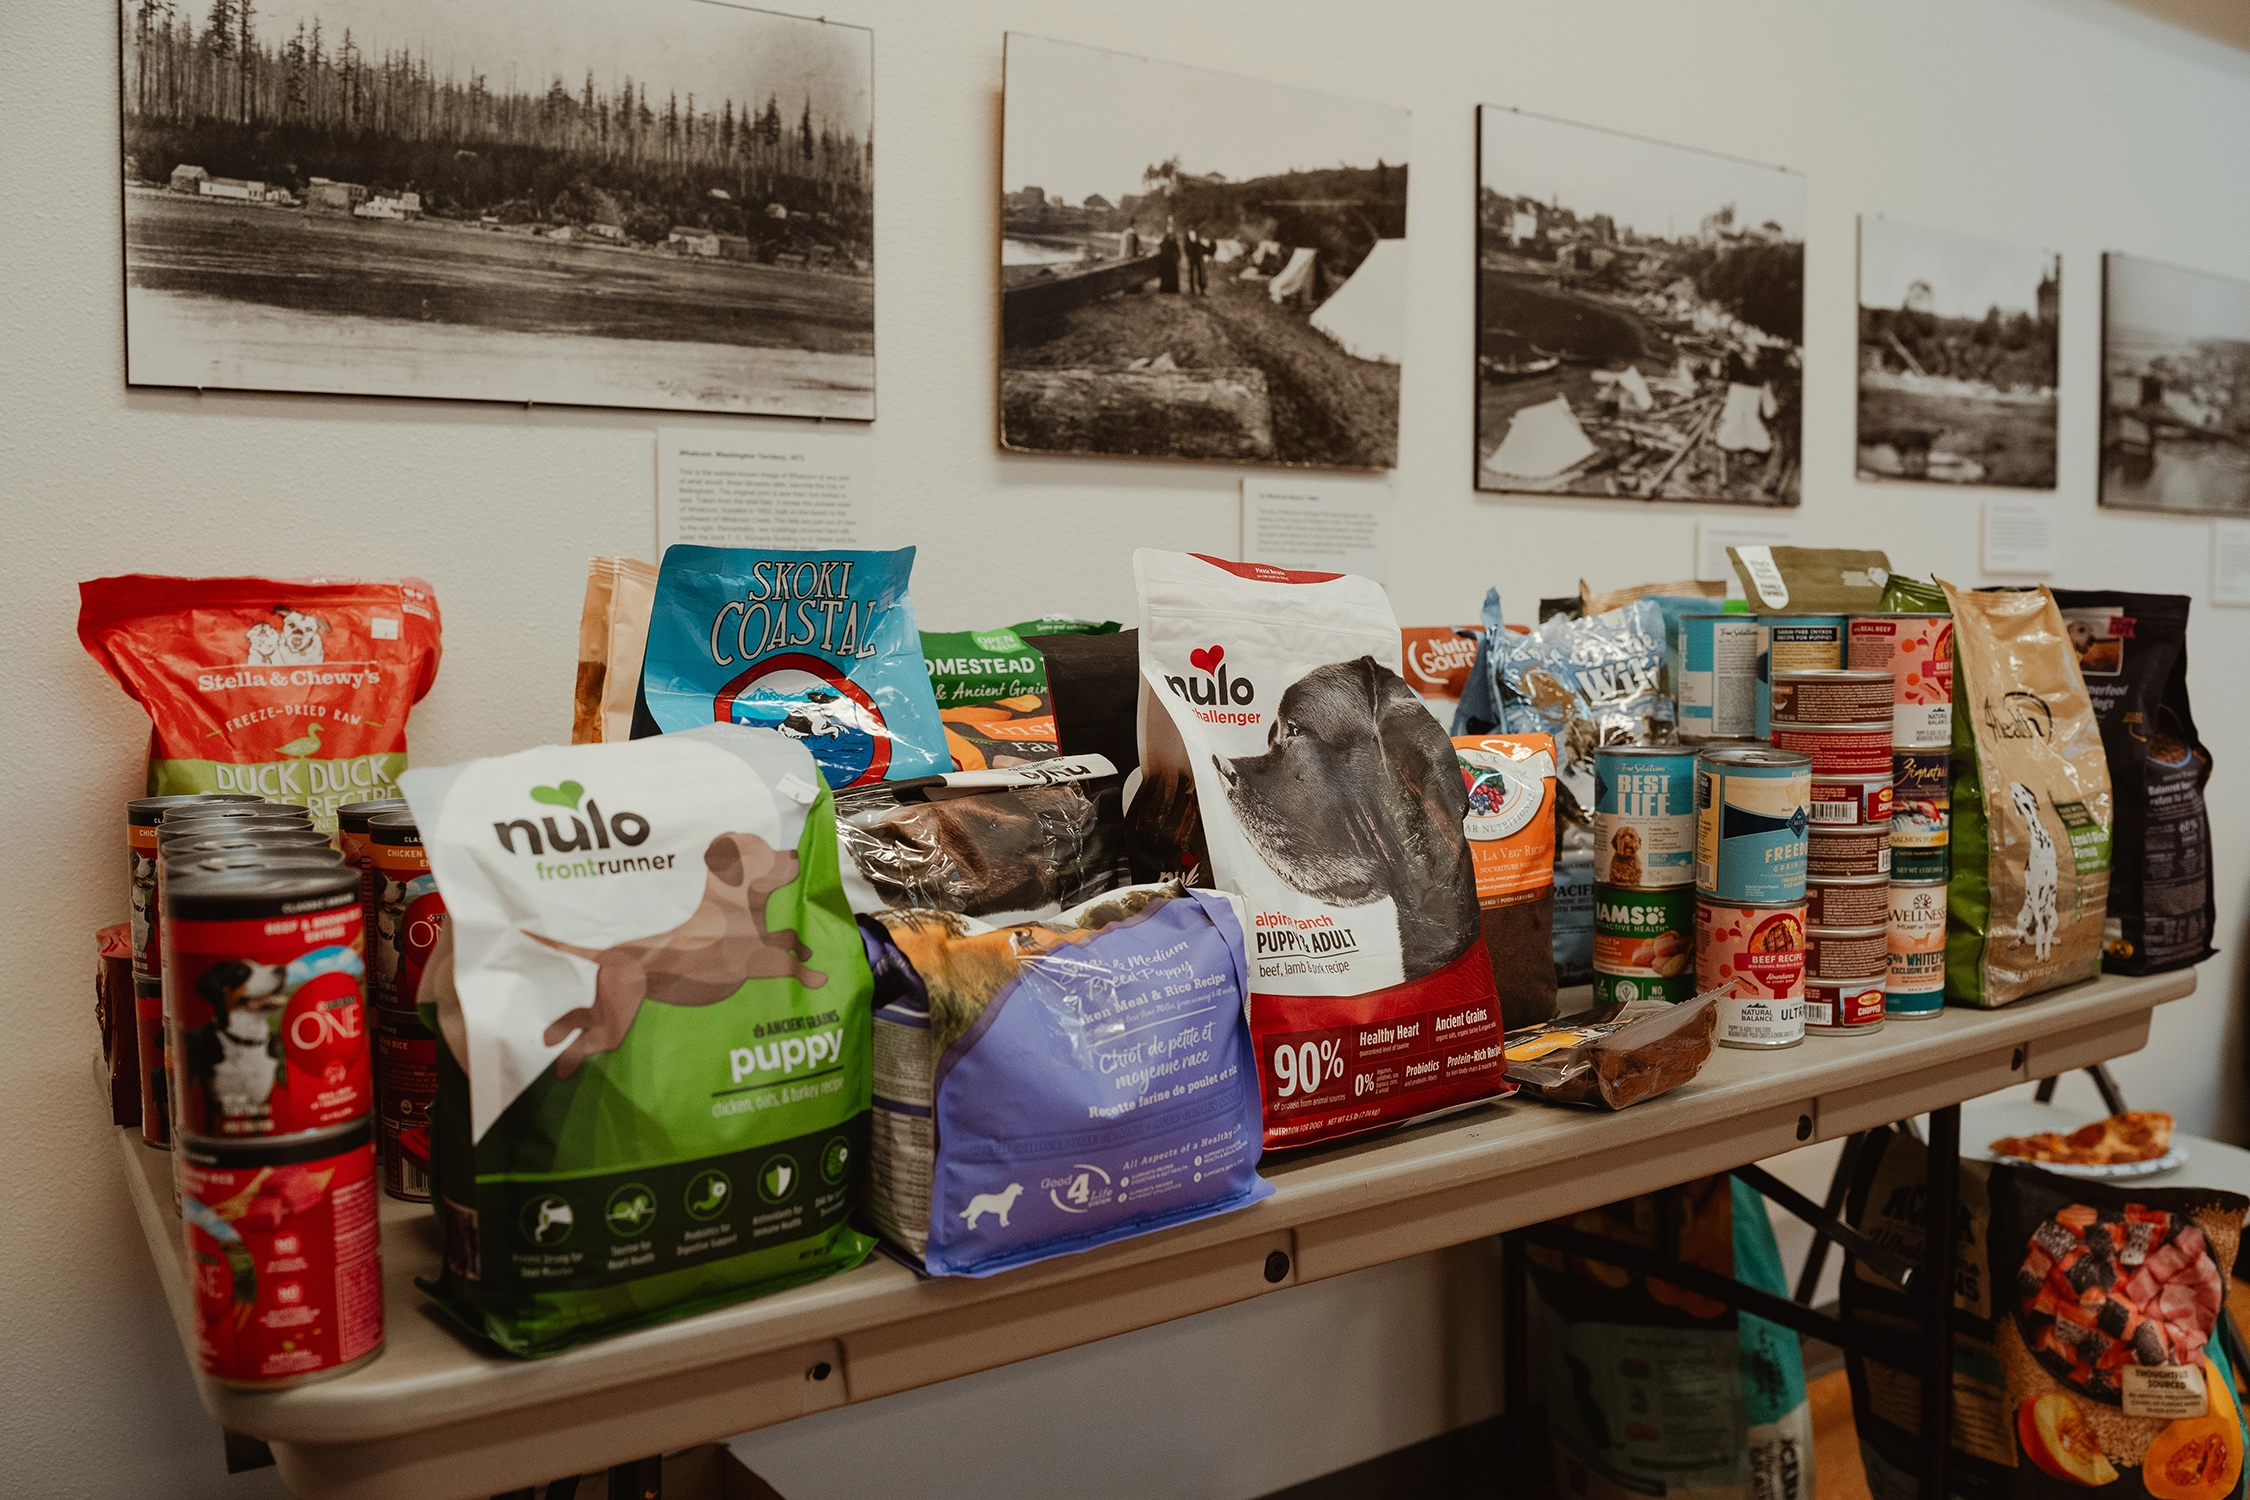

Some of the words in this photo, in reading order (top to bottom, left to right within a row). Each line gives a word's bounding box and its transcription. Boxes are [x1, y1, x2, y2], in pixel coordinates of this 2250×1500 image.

[749, 560, 854, 601] SKOKI
[710, 599, 877, 667] COASTAL
[977, 634, 1015, 645] OPEN
[1861, 625, 1875, 633] REAL
[1429, 638, 1476, 656] Nutri
[925, 657, 1035, 676] OMESTEAD
[1422, 652, 1475, 673] Sourc
[198, 671, 267, 692] Stella
[269, 671, 288, 687] &
[290, 667, 380, 688] Chewy's
[935, 685, 947, 700] &
[951, 681, 1004, 700] Ancient
[1008, 679, 1049, 695] Grain
[1163, 663, 1255, 706] nulo
[2087, 684, 2129, 697] perfood
[225, 704, 326, 733] FREEZE-DRIED
[333, 707, 362, 725] RAW
[1192, 708, 1261, 727] hallenger
[216, 762, 302, 796] DUCK
[309, 757, 391, 793] DUCK
[1901, 757, 1948, 786] Zignatu
[1617, 774, 1670, 793] BEST
[1617, 793, 1670, 816] LIFE
[493, 798, 651, 855] nulo
[1891, 835, 1922, 844] SALMON
[387, 849, 423, 858] CHICKEN
[535, 854, 676, 881] frontrunner
[1773, 862, 1799, 873] GRAIN
[1554, 884, 1594, 898] PACIFI
[1596, 902, 1645, 925] IAMS
[409, 921, 443, 948] ON
[1633, 925, 1665, 933] HEALTH
[1256, 930, 1302, 954] PUPPY
[1311, 928, 1357, 954] ADULT
[1127, 941, 1189, 968] Medium
[1751, 955, 1776, 965] BEEF
[1778, 953, 1803, 963] RECIPE
[1906, 950, 1945, 967] WHITEFIS
[1259, 962, 1284, 977] beef,
[1284, 961, 1307, 975] lamb
[1325, 960, 1350, 975] recipe
[1085, 971, 1139, 1000] Breed
[1135, 960, 1194, 980] Puppy
[1651, 986, 1663, 995] NO
[1113, 992, 1149, 1013] Meal
[1151, 989, 1162, 1001] &
[1163, 981, 1192, 998] Rice
[1192, 973, 1226, 990] Recipe
[1435, 1014, 1465, 1032] Ancient
[1465, 1007, 1488, 1025] Grains
[1741, 1008, 1772, 1016] NATURAL
[1781, 1006, 1803, 1021] ULTR
[291, 1003, 362, 1050] ONE
[1359, 1027, 1395, 1046] Healthy
[1397, 1021, 1420, 1040] Heart
[728, 1028, 844, 1084] puppy
[1098, 1043, 1147, 1075] Chiot
[1148, 1035, 1165, 1057] de
[1167, 1024, 1201, 1054] petite
[1200, 1021, 1216, 1043] et
[1359, 1046, 1383, 1058] guaranteed
[1383, 1045, 1393, 1053] level
[1447, 1048, 1487, 1068] Protein-Rich
[1115, 1057, 1181, 1095] moyenne
[1181, 1049, 1210, 1070] race
[1273, 1037, 1344, 1098] 90%
[1405, 1060, 1440, 1077] Probiotics
[1459, 1067, 1468, 1076] body
[1354, 1072, 1375, 1097] 0%
[1404, 1079, 1412, 1087] and
[1088, 1101, 1136, 1119] Recette
[1138, 1090, 1171, 1108] farine
[1172, 1083, 1186, 1096] de
[1187, 1075, 1218, 1094] poulet
[1218, 1070, 1228, 1081] et
[1273, 1102, 1280, 1111] of
[1280, 1099, 1300, 1112] protein
[1300, 1098, 1312, 1108] from
[1312, 1096, 1329, 1106] animal
[1328, 1093, 1346, 1103] sources
[1269, 1125, 1300, 1136] NUTRITION
[1300, 1123, 1309, 1133] FOR
[1309, 1120, 1324, 1130] DOGS
[1327, 1116, 1338, 1126] NET
[1122, 1158, 1138, 1171] All
[1140, 1148, 1178, 1166] Aspects
[1180, 1142, 1191, 1154] of
[1192, 1142, 1199, 1150] a
[1201, 1130, 1233, 1148] Healthy
[1040, 1174, 1074, 1190] Good
[1066, 1173, 1091, 1205] 4
